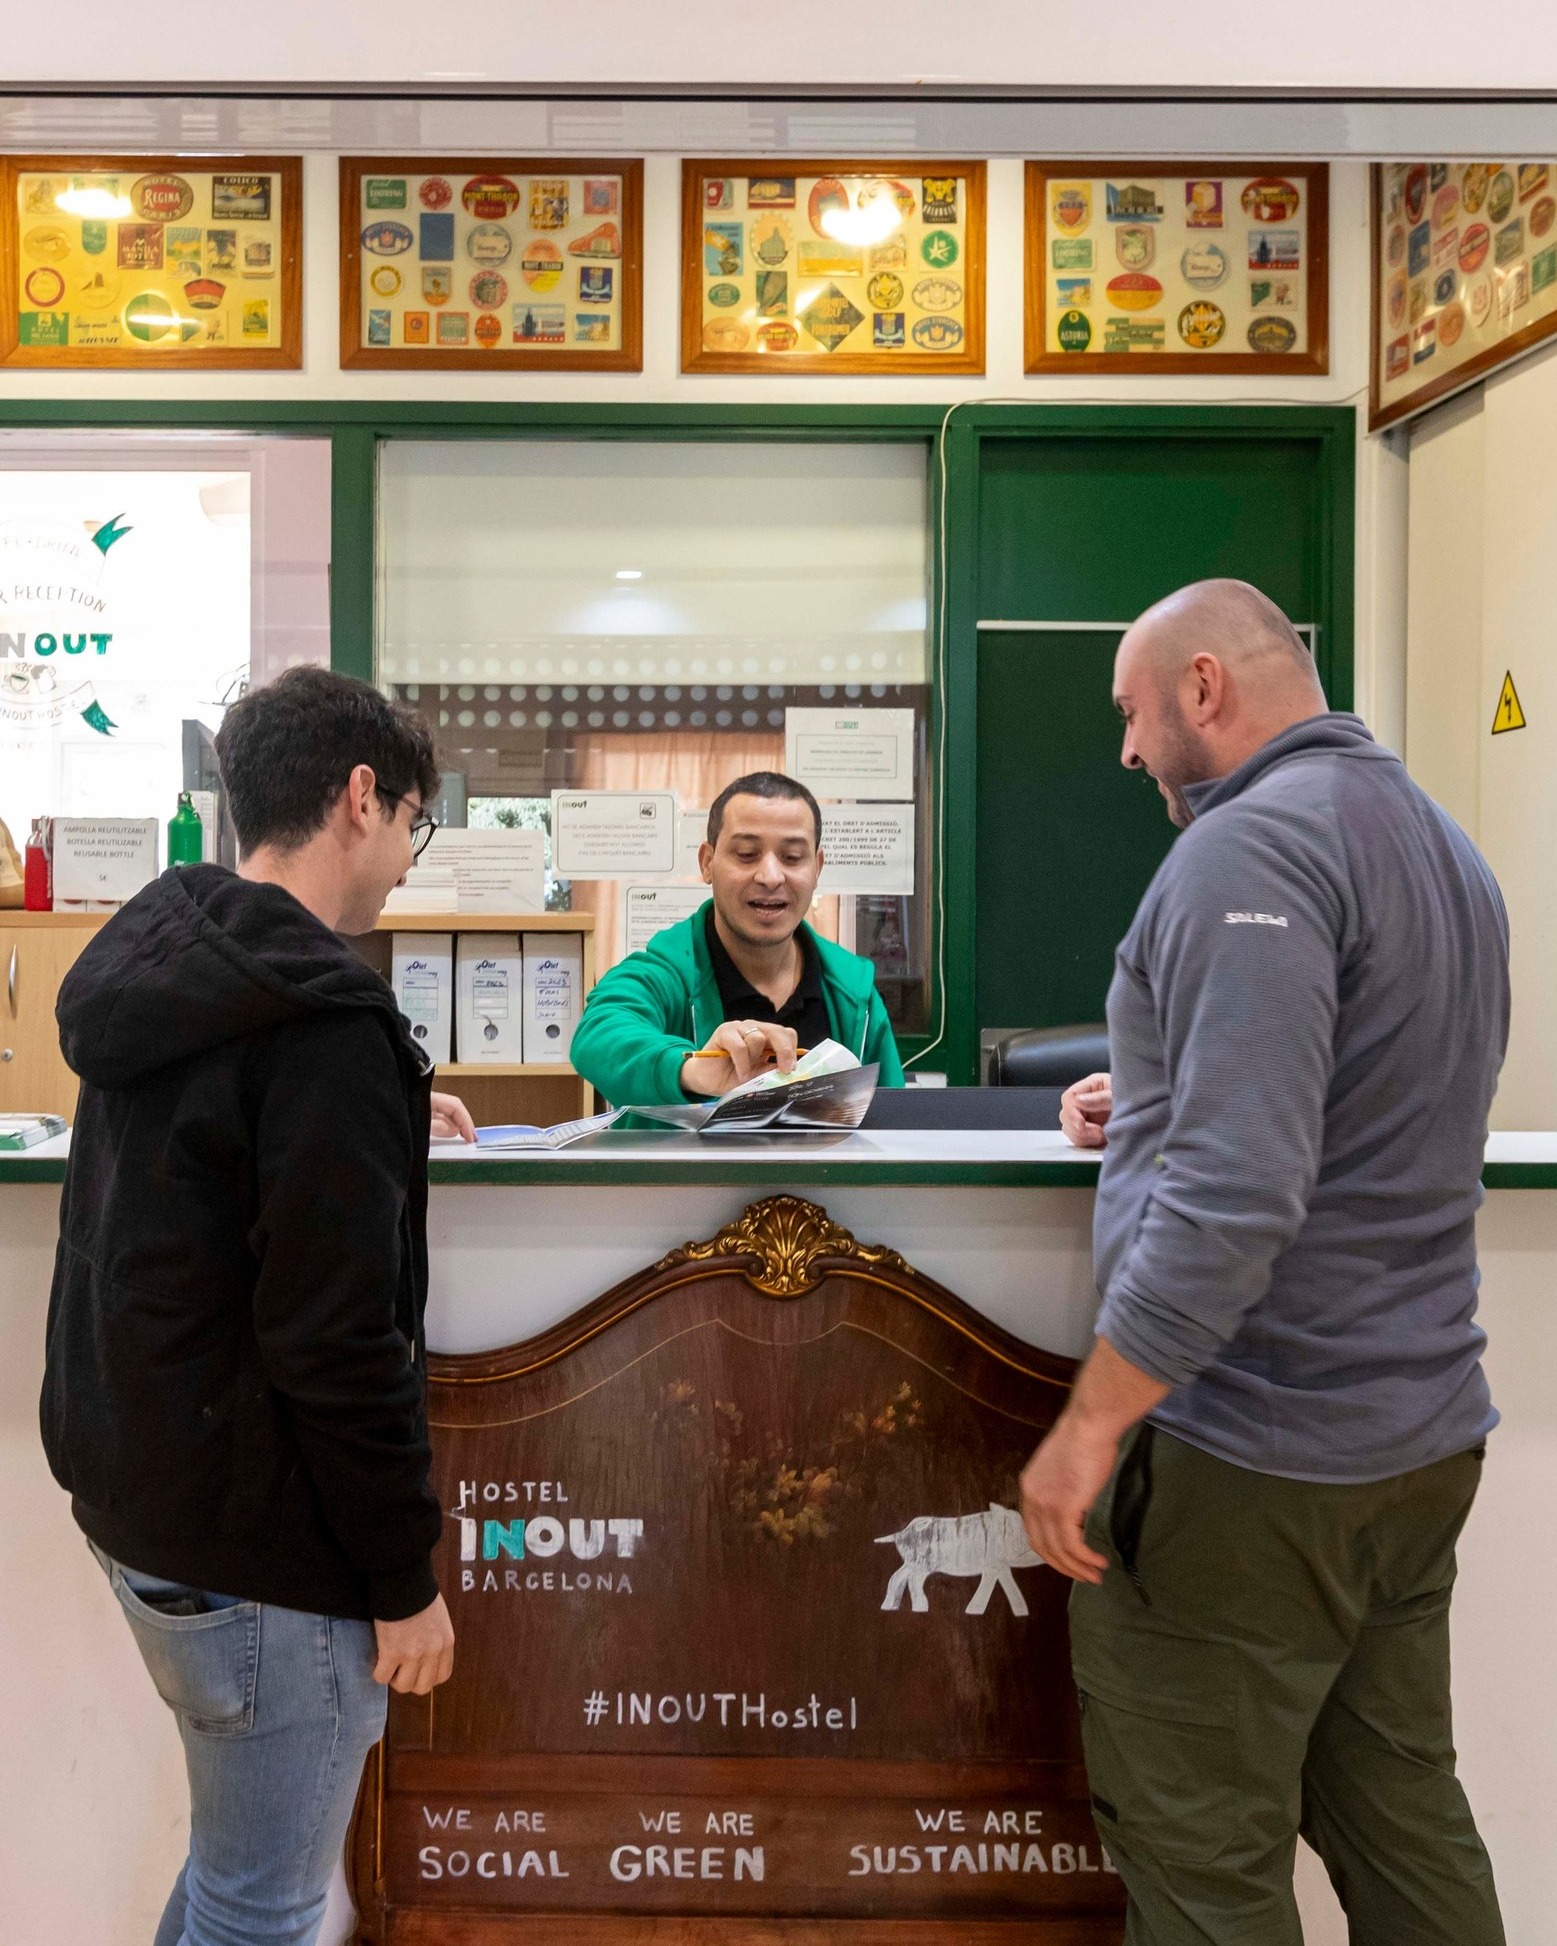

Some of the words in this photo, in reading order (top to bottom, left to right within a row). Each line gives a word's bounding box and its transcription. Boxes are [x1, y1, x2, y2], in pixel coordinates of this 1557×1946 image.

[144, 188, 181, 208] REGINA
[0, 633, 113, 658] NOUT
[74, 850, 107, 858] REUSABLE
[109, 850, 134, 858] BOTTLE
[459, 1480, 569, 1504] HOSTEL
[460, 1515, 644, 1562] INOUT
[461, 1569, 634, 1594] BARCELONA
[423, 1805, 473, 1832] WE
[494, 1810, 547, 1834] ARE
[640, 1810, 682, 1836] WE
[705, 1810, 755, 1837] ARE
[915, 1807, 966, 1835] WE
[983, 1809, 1044, 1836] ARE
[419, 1844, 571, 1880] SOCIAL
[609, 1844, 766, 1883] GREEN
